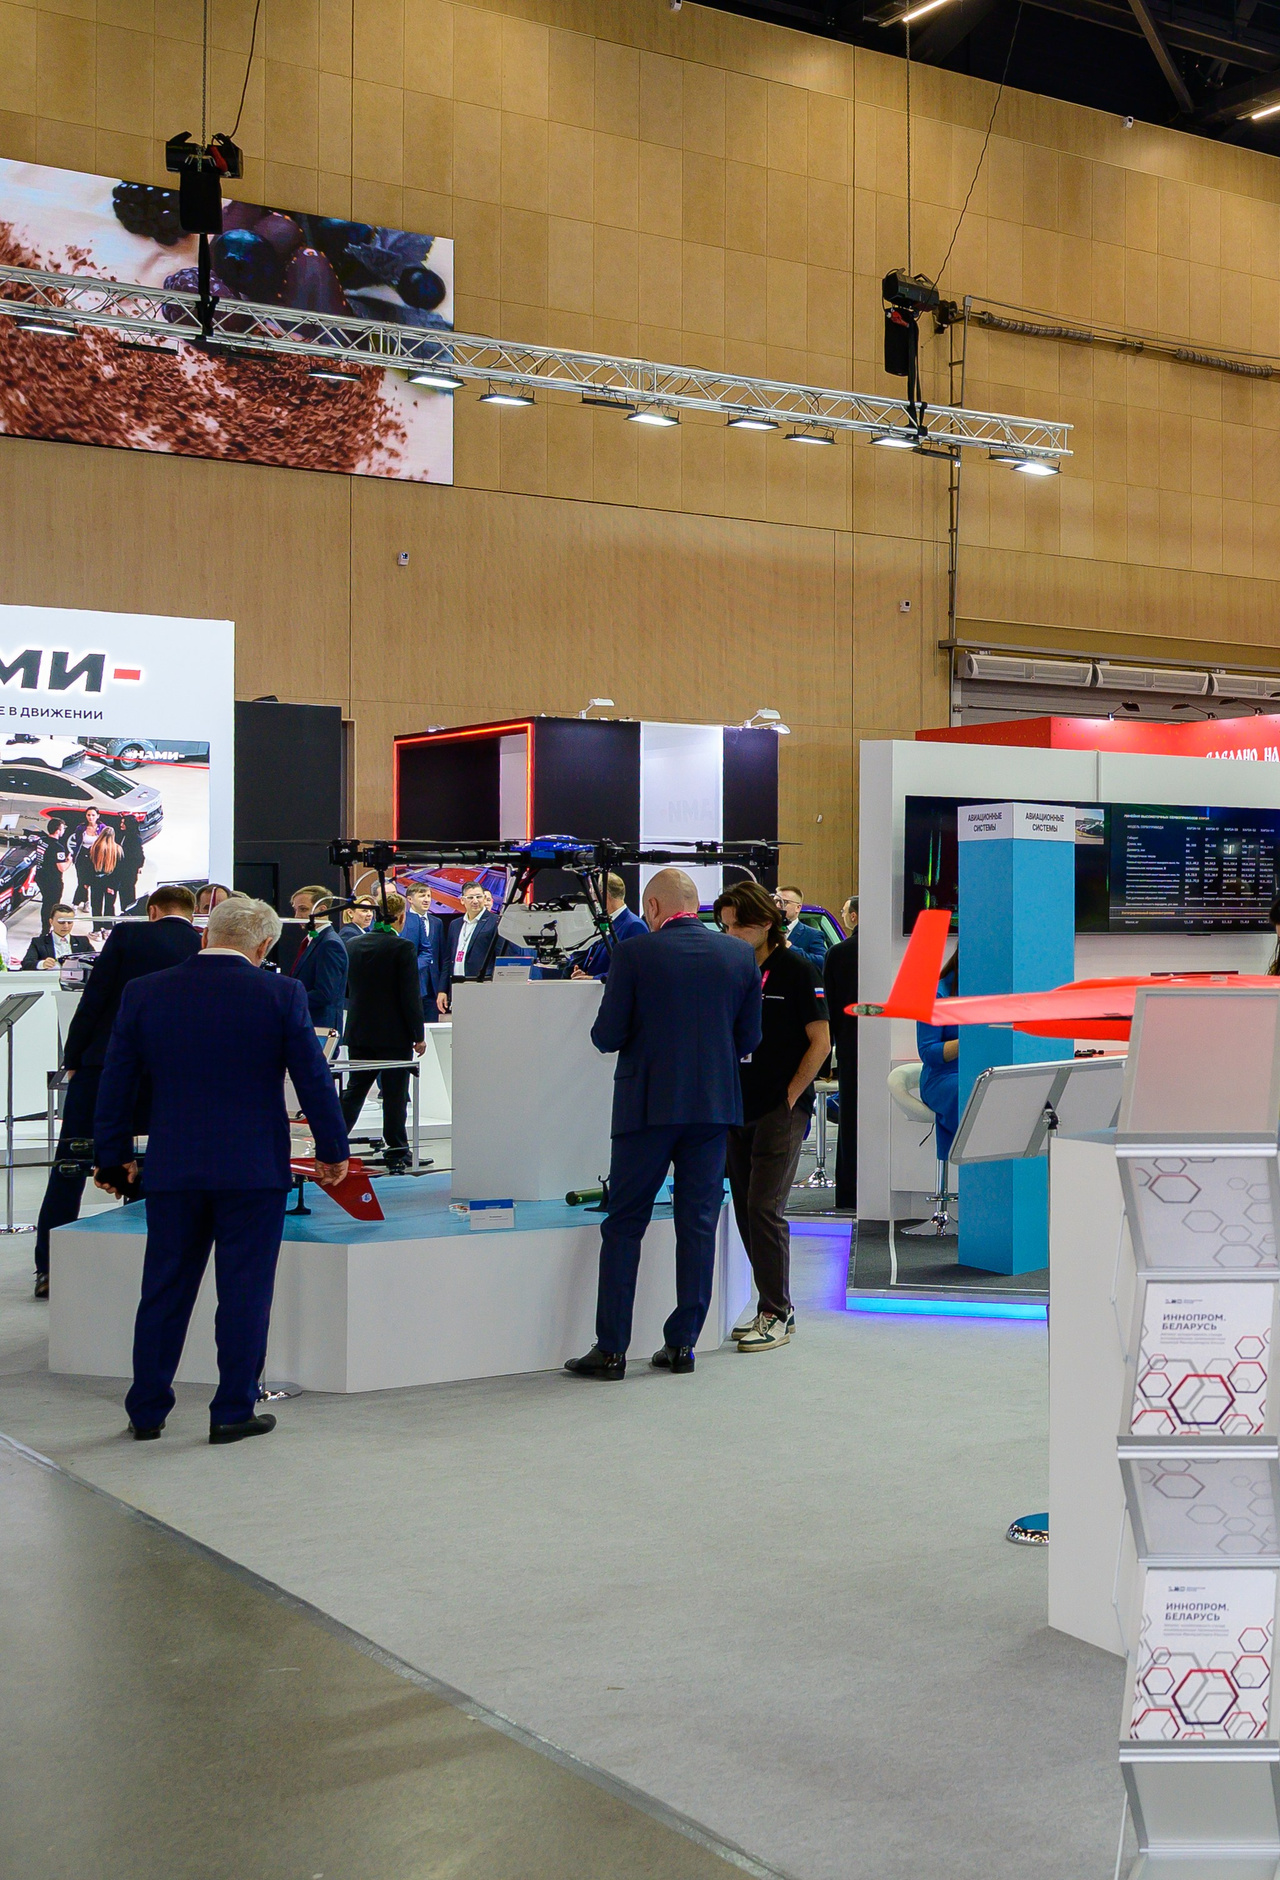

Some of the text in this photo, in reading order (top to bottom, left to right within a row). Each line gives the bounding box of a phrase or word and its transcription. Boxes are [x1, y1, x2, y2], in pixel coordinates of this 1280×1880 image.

[9, 706, 17, 716] В
[20, 707, 103, 720] ДВИЖЕНИИ
[1264, 746, 1280, 763] НА
[968, 812, 1002, 822] АВИАЦИОННЫЕ
[1025, 812, 1064, 822] АВИАЦИОННЫЕ
[974, 824, 996, 832] СИСТЕМЫ
[1032, 824, 1058, 832] СИСТЕМЫ
[1163, 1314, 1226, 1322] ИННОПРОМ.
[1166, 1602, 1229, 1611] ИННОПРОМ.
[1165, 1613, 1220, 1621] БЕЛАРУСЬ
